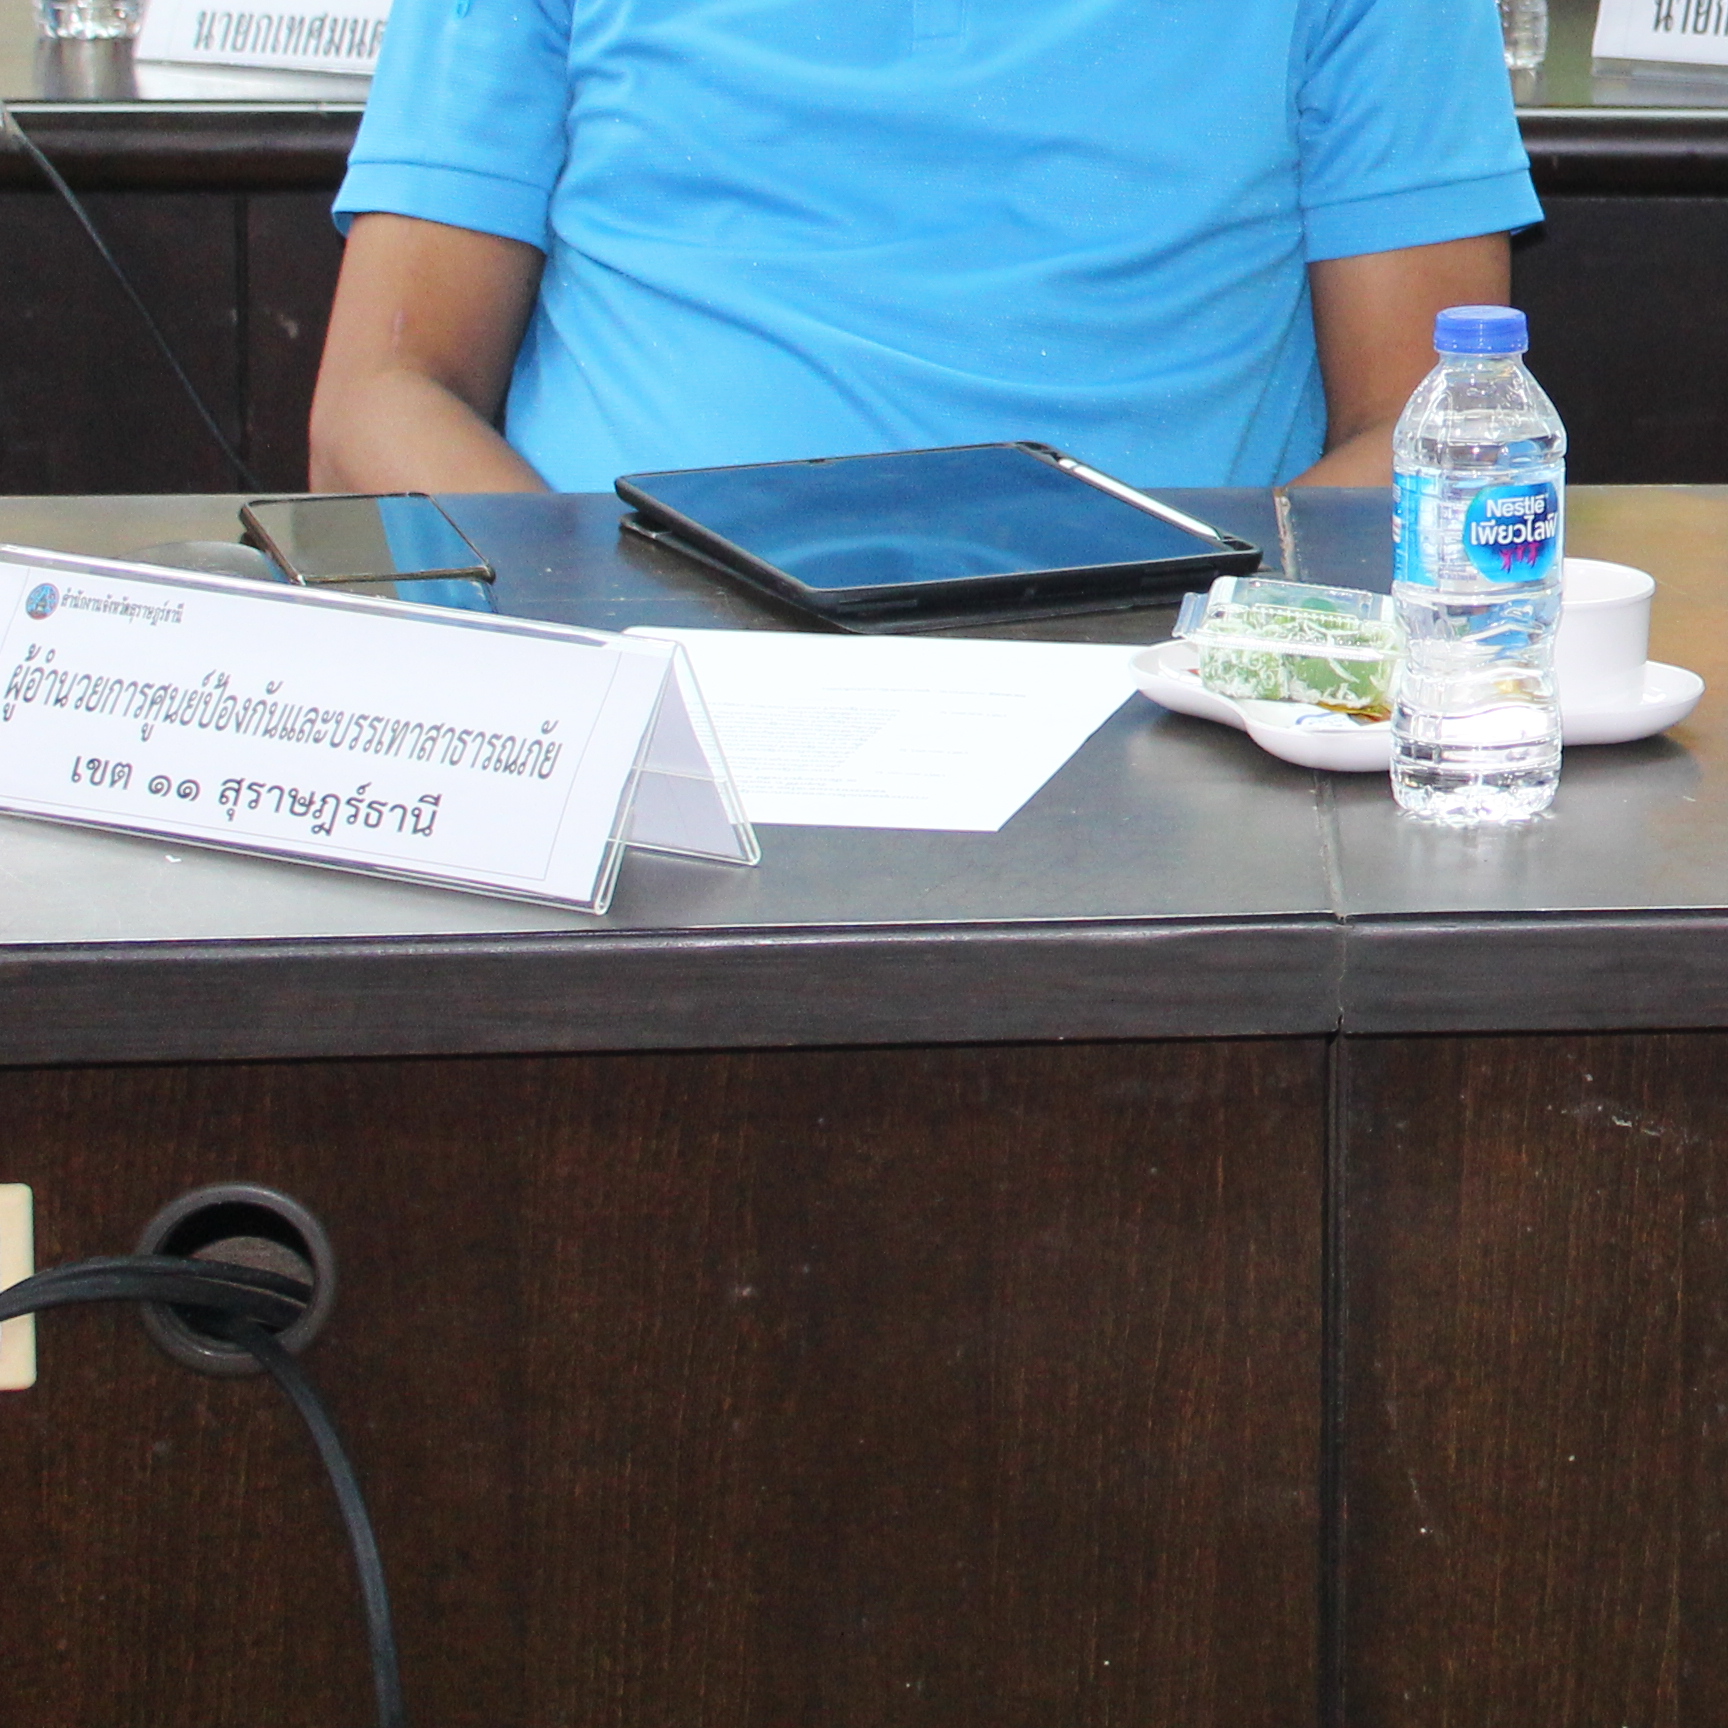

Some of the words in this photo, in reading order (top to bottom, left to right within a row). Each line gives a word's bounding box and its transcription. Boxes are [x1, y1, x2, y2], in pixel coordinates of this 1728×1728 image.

[2, 643, 562, 779] ผู้อำนวยการศูนย์ป้องกันและบรรเทาสาธารณภัย
[71, 755, 133, 790] เขต
[147, 774, 201, 802] ๑๑
[218, 777, 442, 837] สุราษฎร์ธานี
